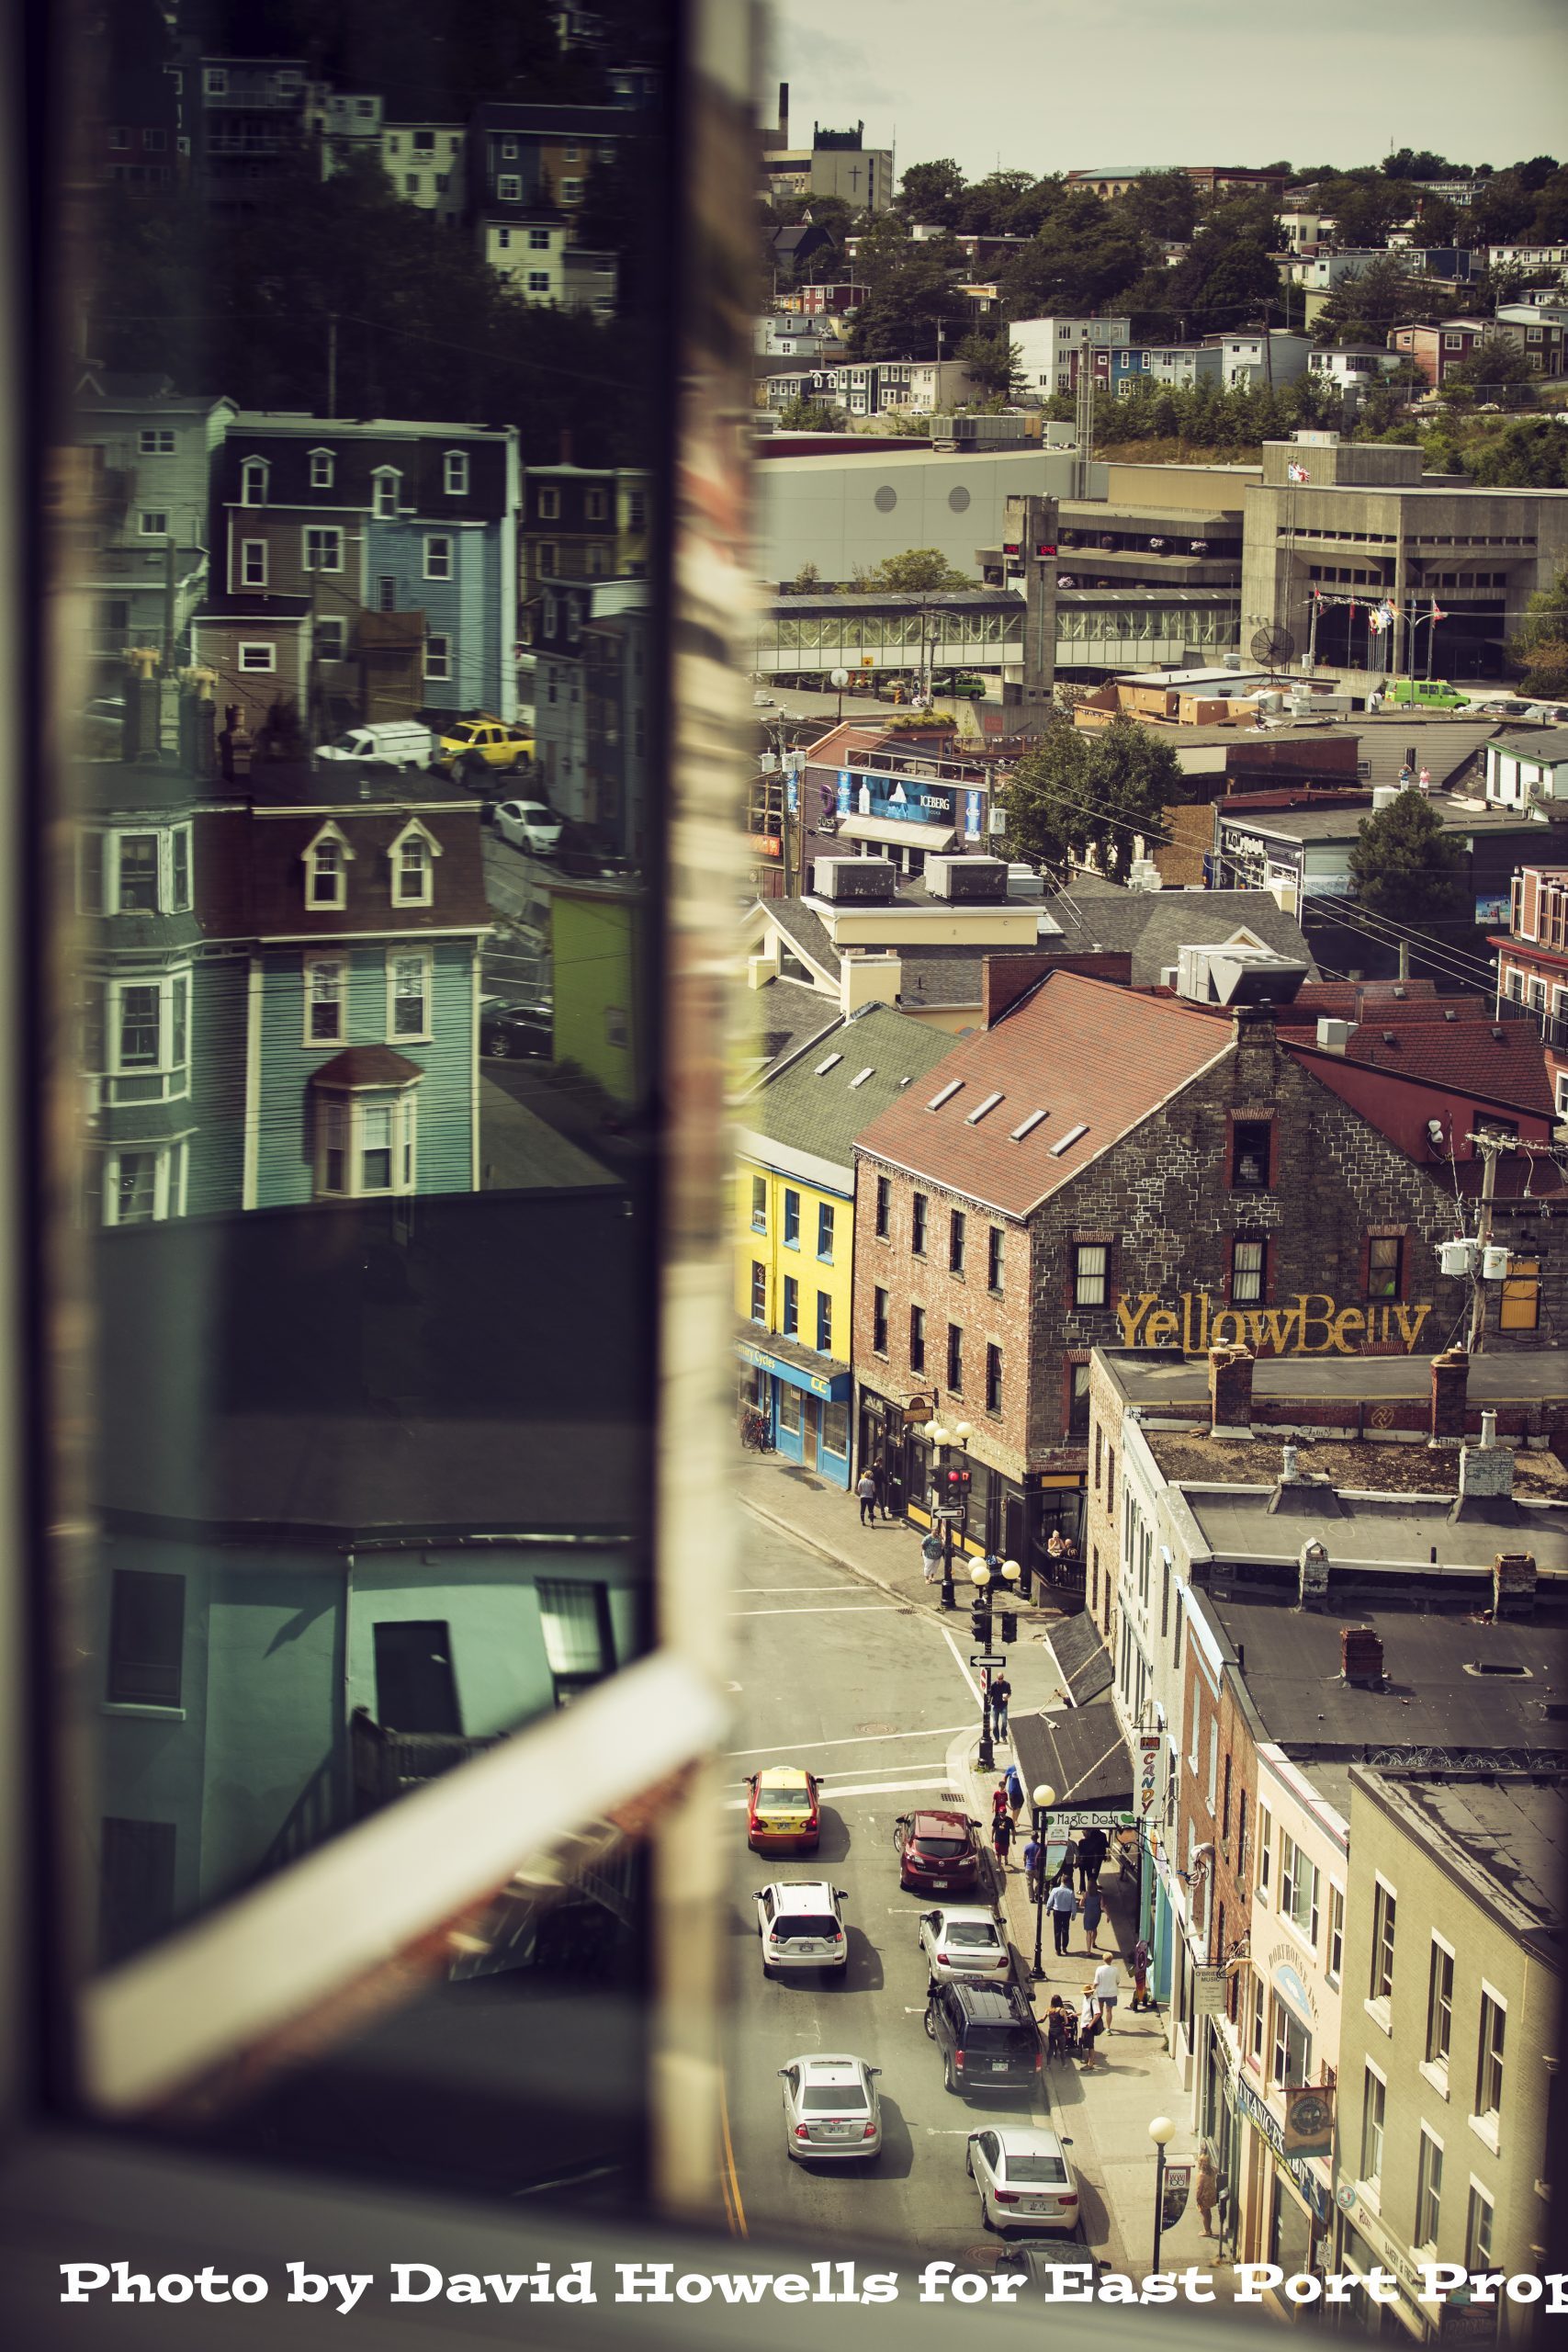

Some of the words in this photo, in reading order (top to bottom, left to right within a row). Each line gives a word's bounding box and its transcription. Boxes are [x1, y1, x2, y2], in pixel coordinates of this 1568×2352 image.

[920, 795, 950, 809] ICEBERG
[1116, 1293, 1431, 1354] YellowBelly
[754, 1351, 776, 1370] Cycles
[1141, 1751, 1156, 1815] CANDY
[1056, 1813, 1089, 1827] Magic
[1238, 2077, 1273, 2136] TITANIC
